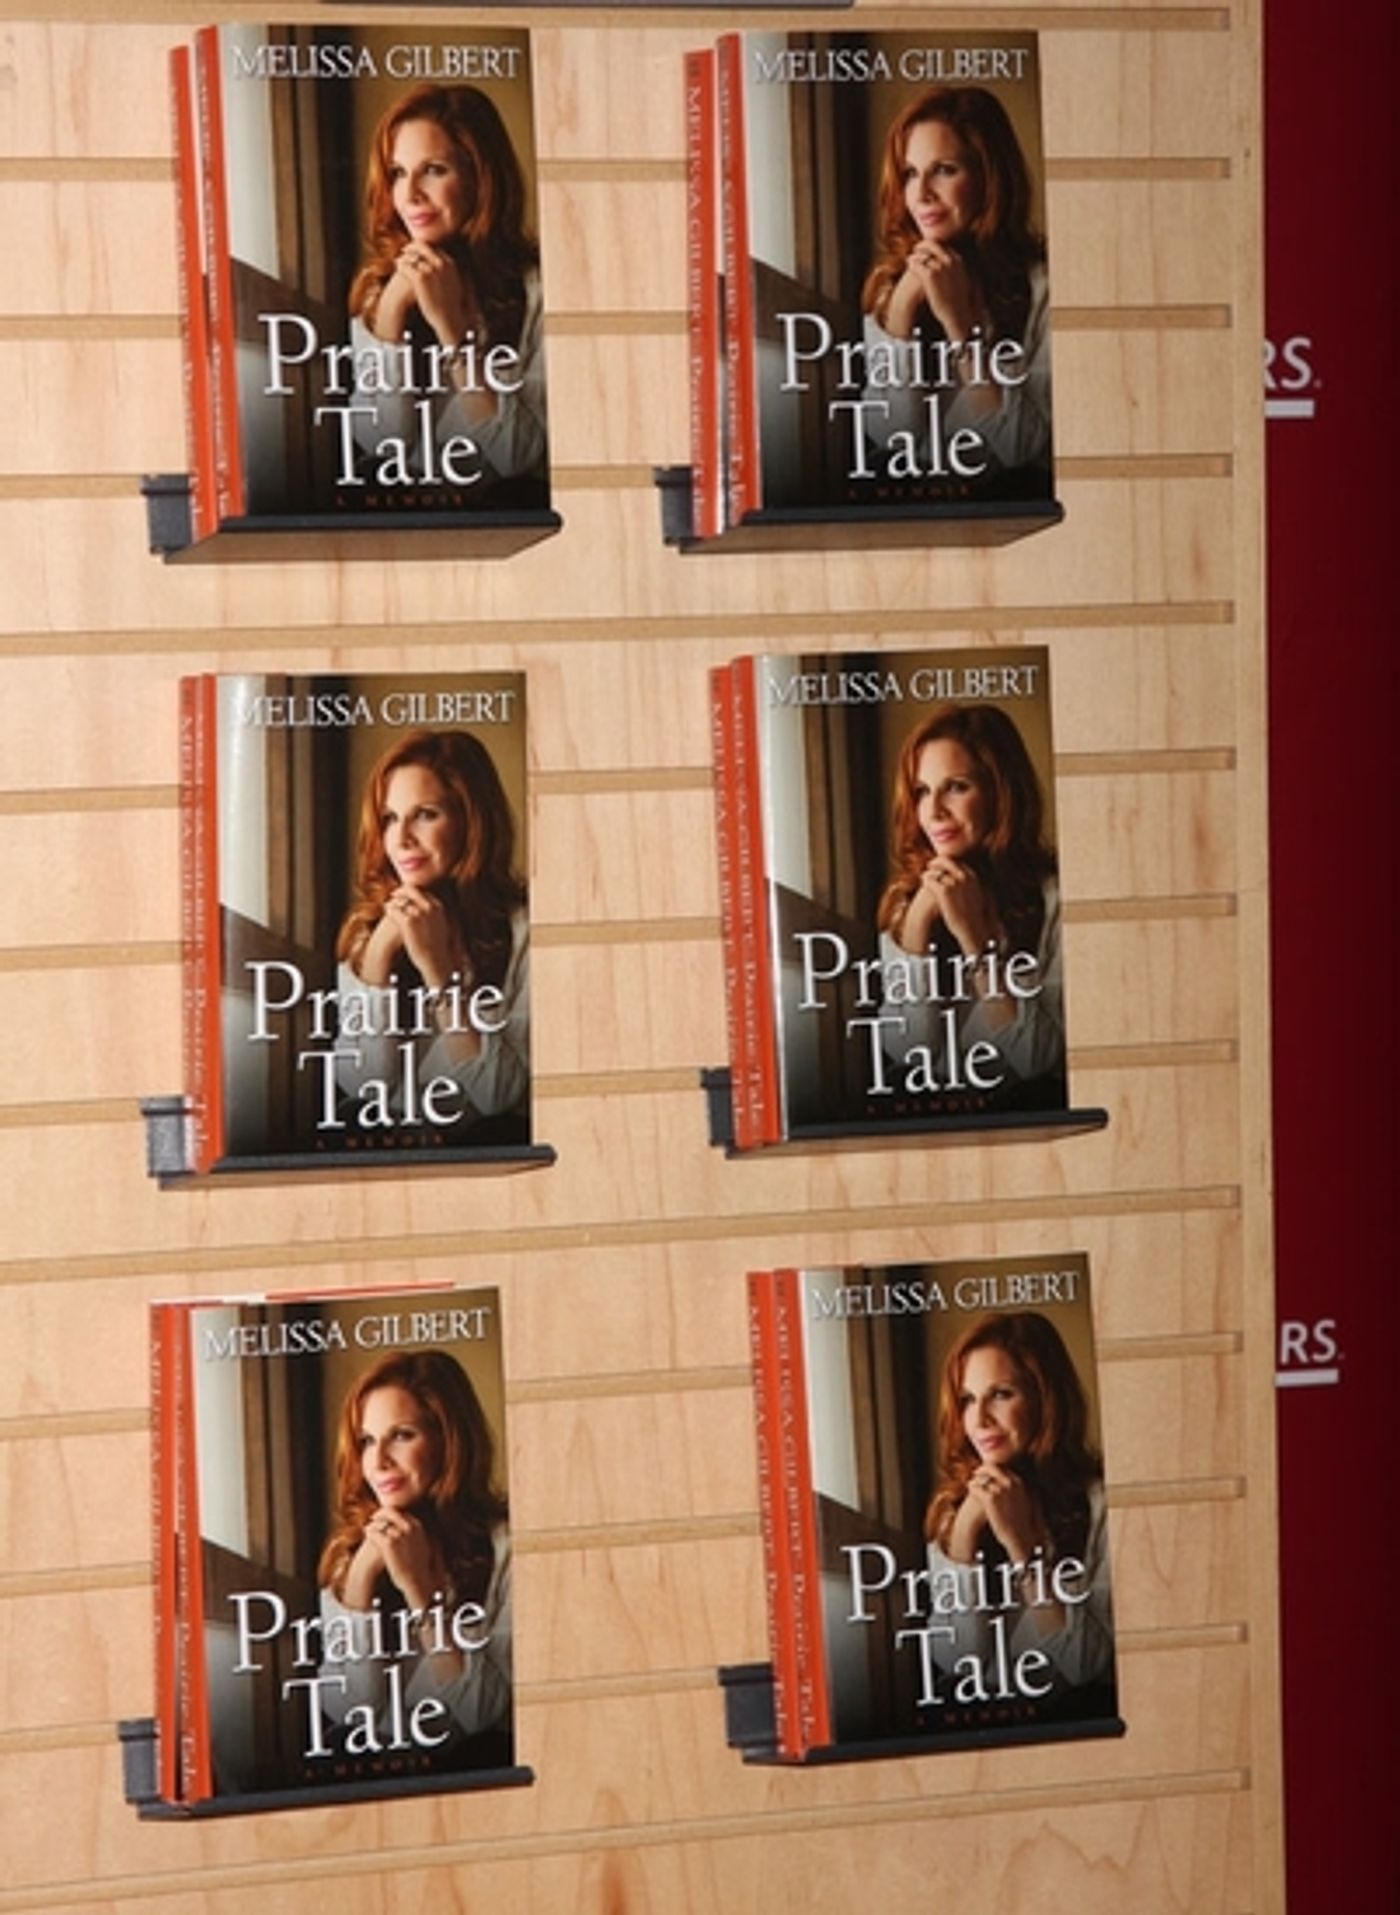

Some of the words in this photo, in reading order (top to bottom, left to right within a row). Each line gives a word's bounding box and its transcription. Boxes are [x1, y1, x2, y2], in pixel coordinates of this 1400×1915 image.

[231, 46, 378, 80] MELISSA
[386, 45, 522, 80] GILBERT
[752, 50, 893, 84] MELISSA
[900, 48, 1028, 82] GILBERT
[258, 313, 524, 396] Prairie
[776, 312, 1029, 392] Prairie
[314, 401, 483, 487] Tale
[829, 395, 988, 480] Tale
[236, 693, 375, 727] MELISSA
[380, 692, 516, 726] GILBERT
[765, 672, 903, 707] MELISSA
[909, 666, 1040, 702] GILBERT
[244, 961, 508, 1042] Prairie
[792, 931, 1044, 1012] Prairie
[298, 1045, 465, 1130] Tale
[846, 1010, 1005, 1097] Tale
[203, 1321, 348, 1363] MELISSA
[354, 1308, 491, 1350] GILBERT
[811, 1281, 949, 1321] MELISSA
[954, 1271, 1082, 1309] GILBERT
[839, 1542, 1092, 1624] Prairie
[227, 1591, 490, 1674] Prairie
[895, 1617, 1055, 1707] Tale
[281, 1666, 452, 1758] Tale
